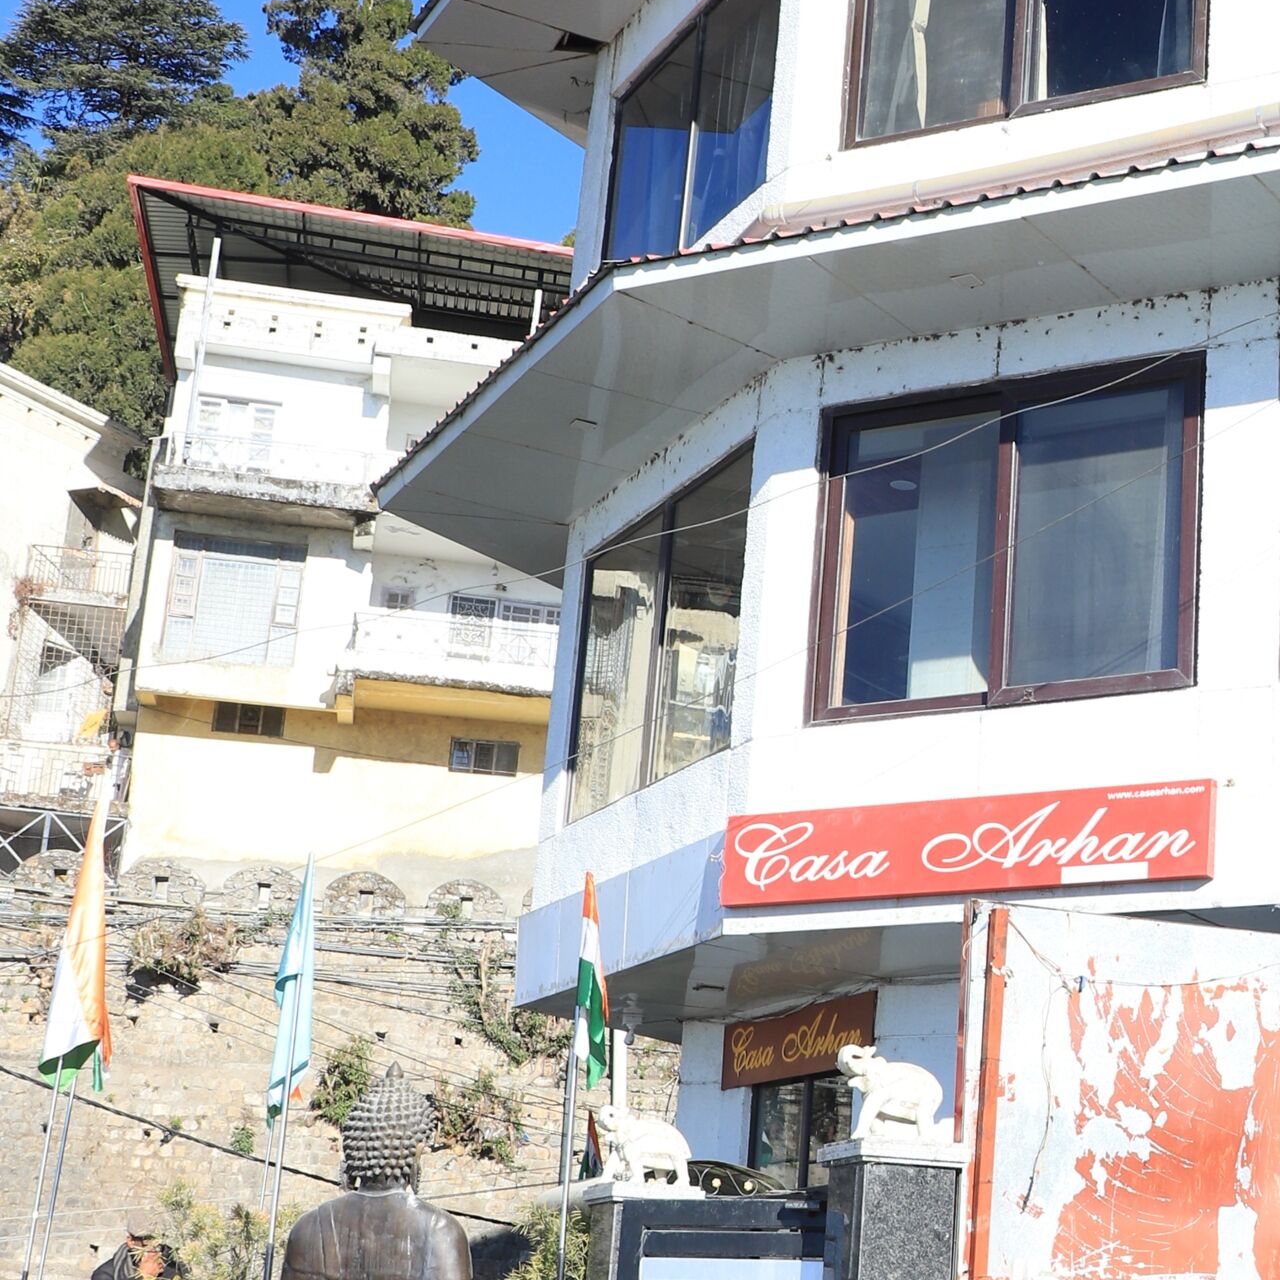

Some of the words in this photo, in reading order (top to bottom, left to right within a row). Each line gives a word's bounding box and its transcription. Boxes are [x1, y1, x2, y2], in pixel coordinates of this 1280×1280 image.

[1106, 785, 1206, 801] www.casaarhan.com
[734, 822, 891, 892] Casa
[921, 800, 1198, 874] Arhan
[731, 1025, 775, 1077] Casa
[781, 1008, 863, 1062] Arhan
